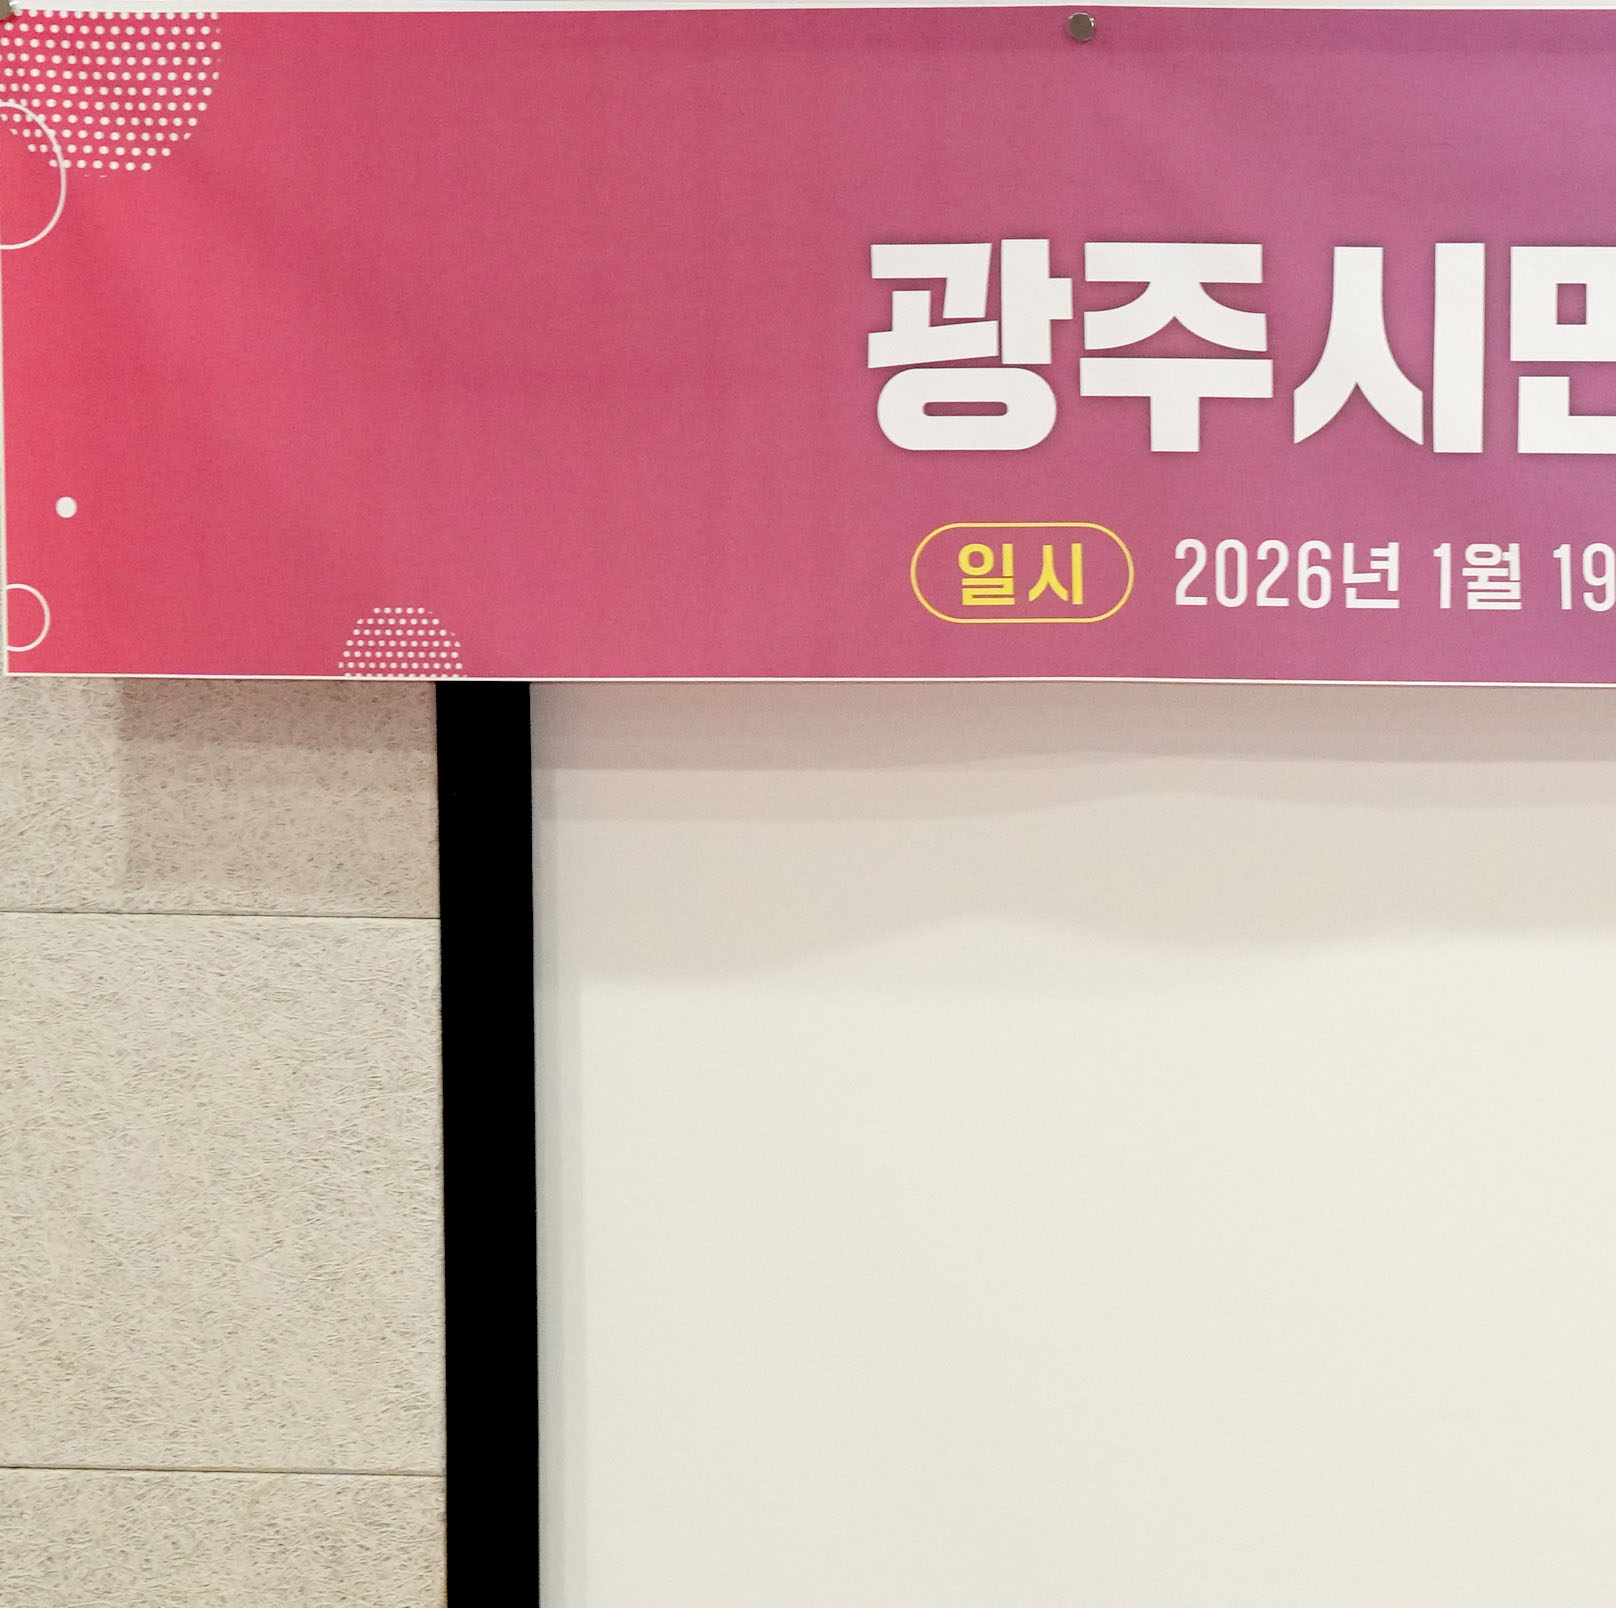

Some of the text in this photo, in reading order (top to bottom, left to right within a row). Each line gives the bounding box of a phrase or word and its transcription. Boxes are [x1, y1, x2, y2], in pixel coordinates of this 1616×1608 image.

[957, 542, 1084, 607] 일시
[1174, 537, 1401, 610] 2026년
[1432, 541, 1523, 611] 1월
